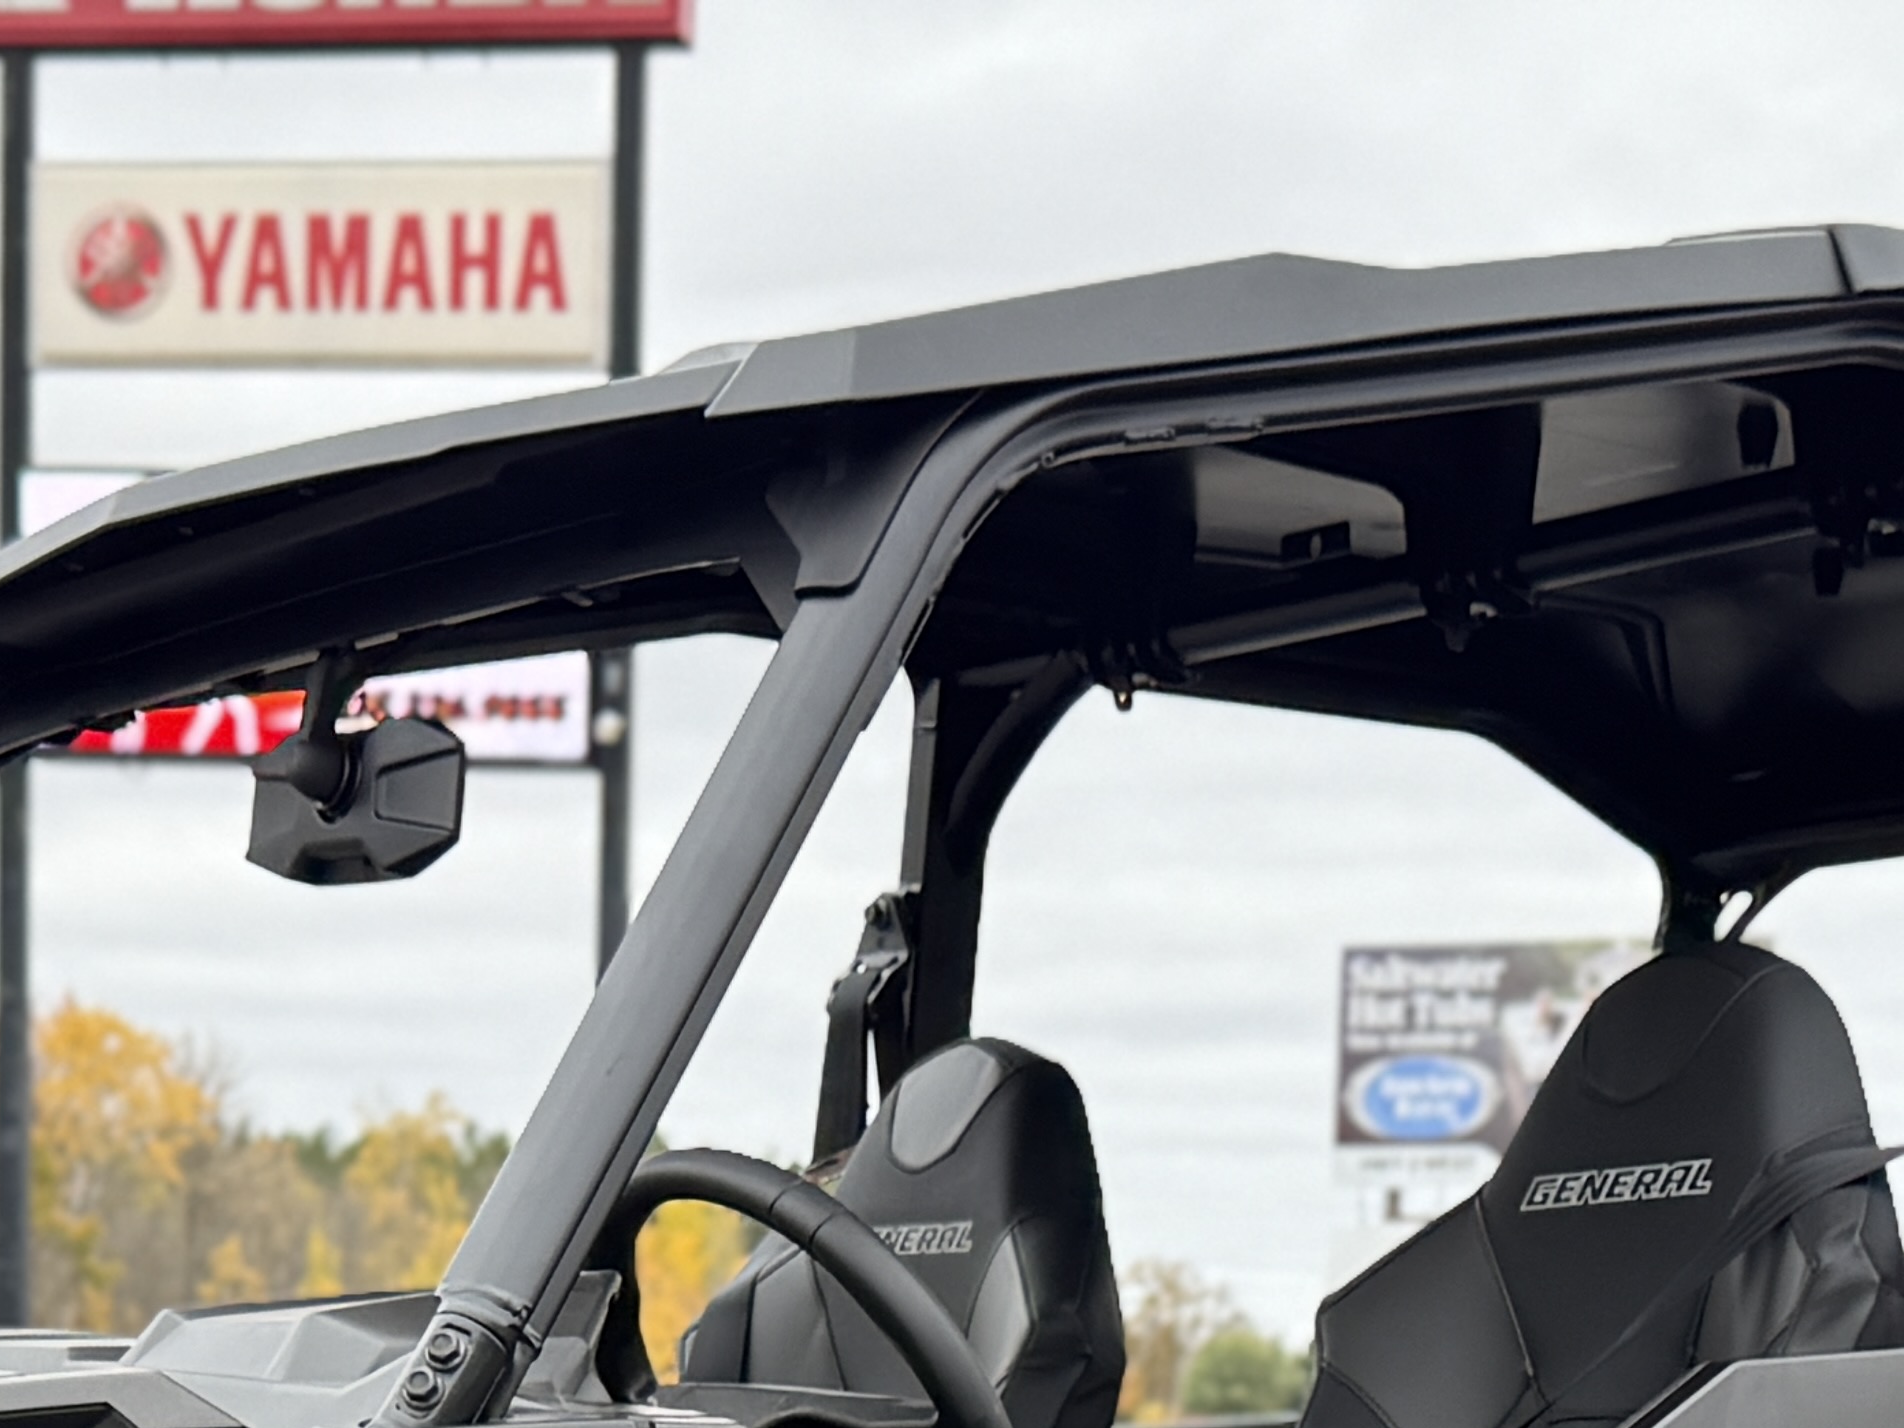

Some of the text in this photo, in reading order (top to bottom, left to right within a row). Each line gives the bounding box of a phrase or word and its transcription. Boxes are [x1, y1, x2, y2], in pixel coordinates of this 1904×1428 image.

[184, 210, 569, 313] YAMAHA
[1520, 1158, 1712, 1212] GENERAL
[872, 1219, 973, 1256] NERAL
